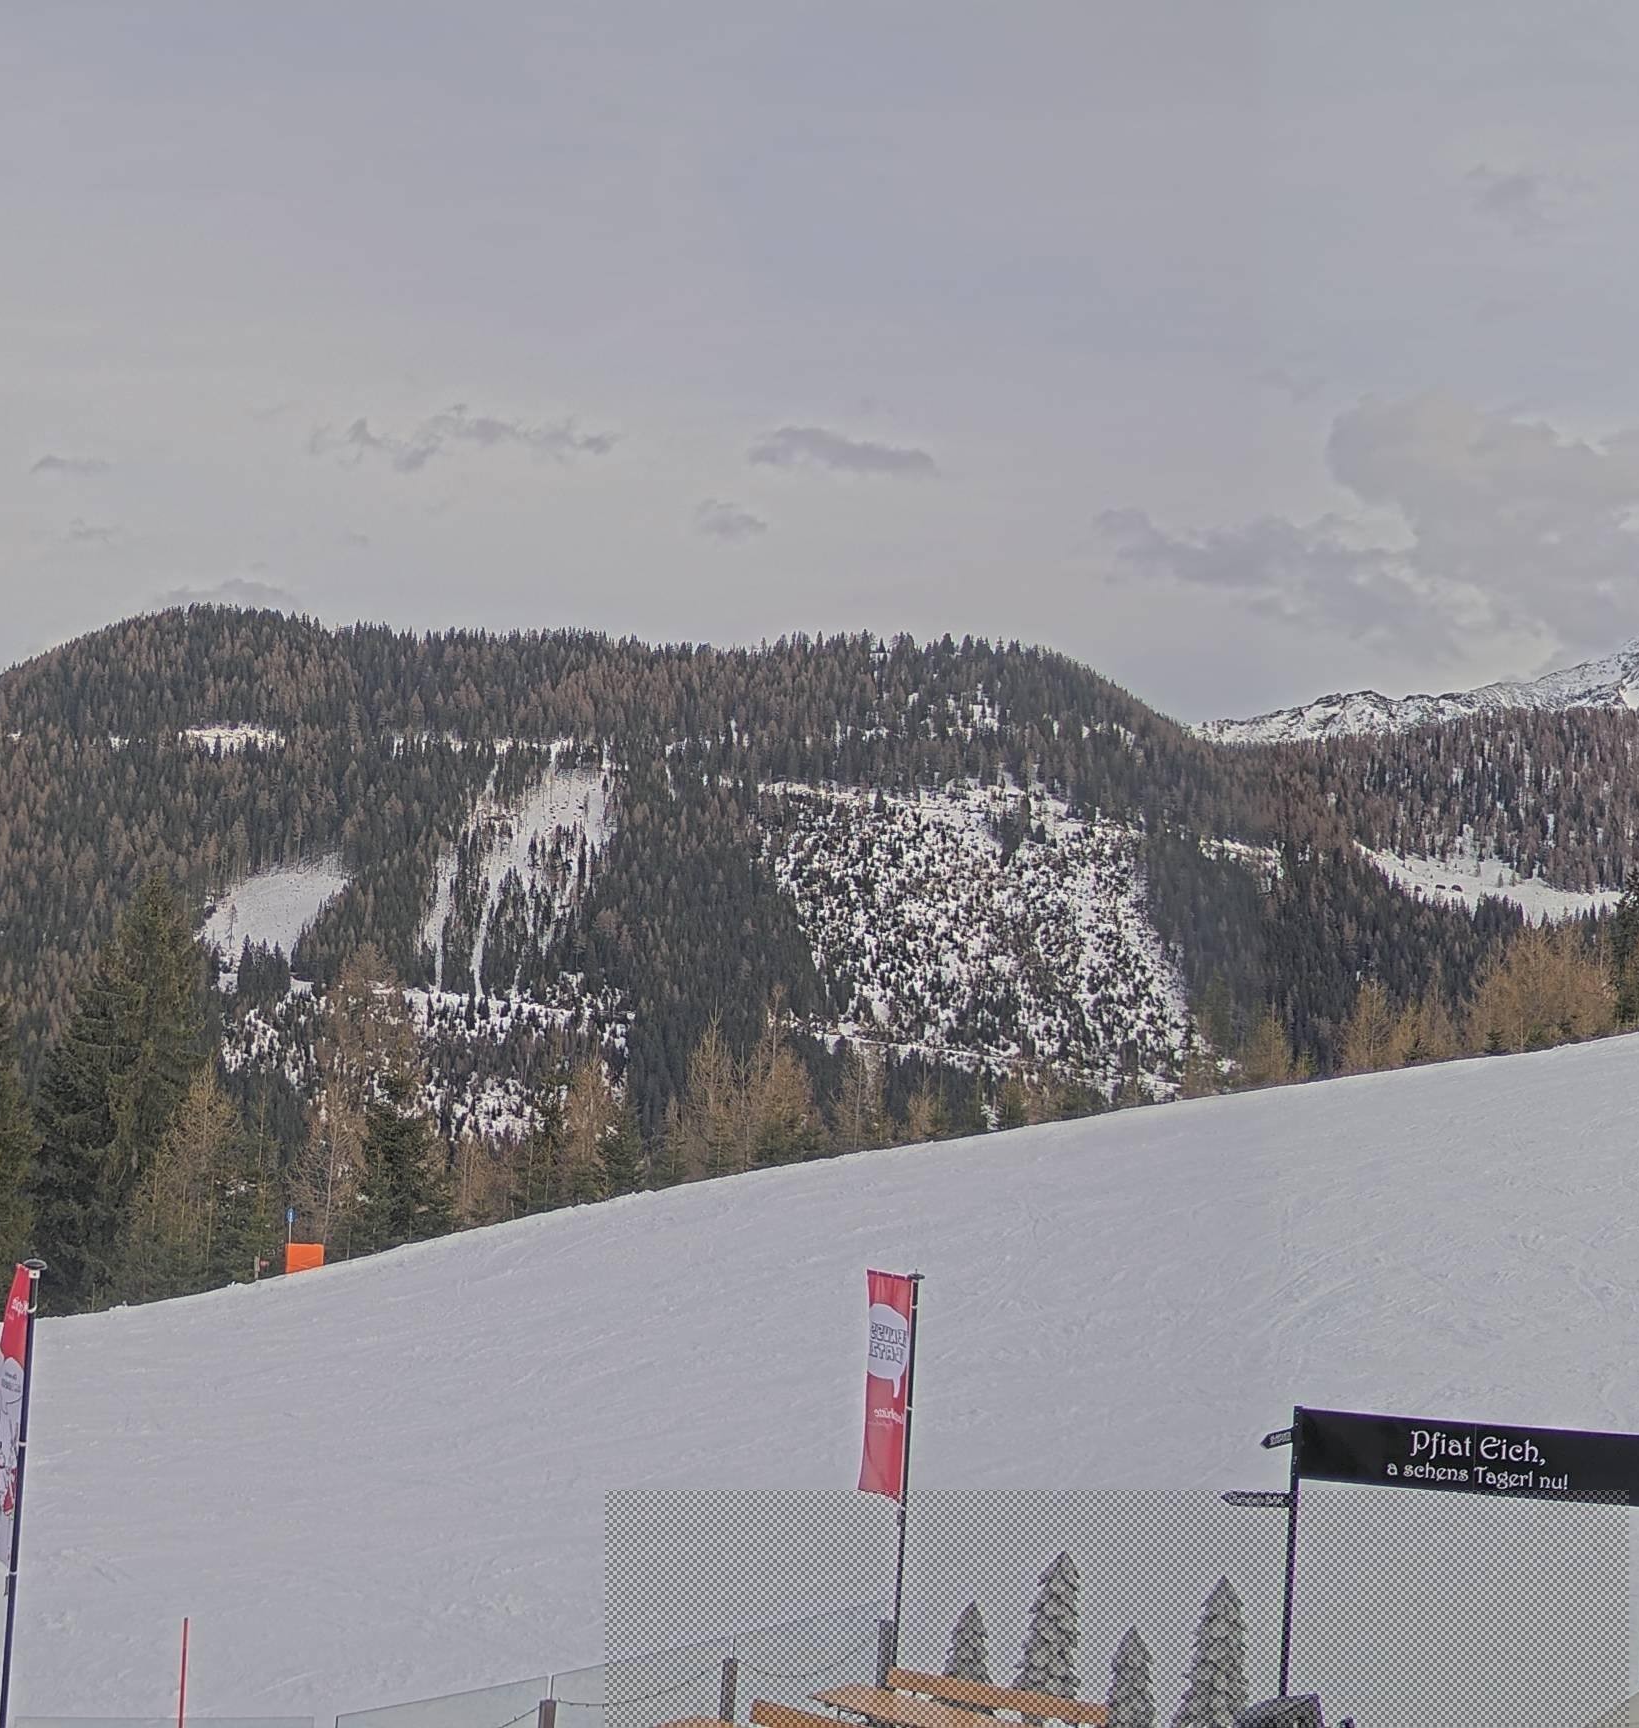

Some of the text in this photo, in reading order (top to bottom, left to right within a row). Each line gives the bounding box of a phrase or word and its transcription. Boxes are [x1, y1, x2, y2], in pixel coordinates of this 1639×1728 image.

[1410, 1430, 1546, 1466] Pfiat Eich,
[1387, 1462, 1569, 1490] a schens Tagerl nu!
